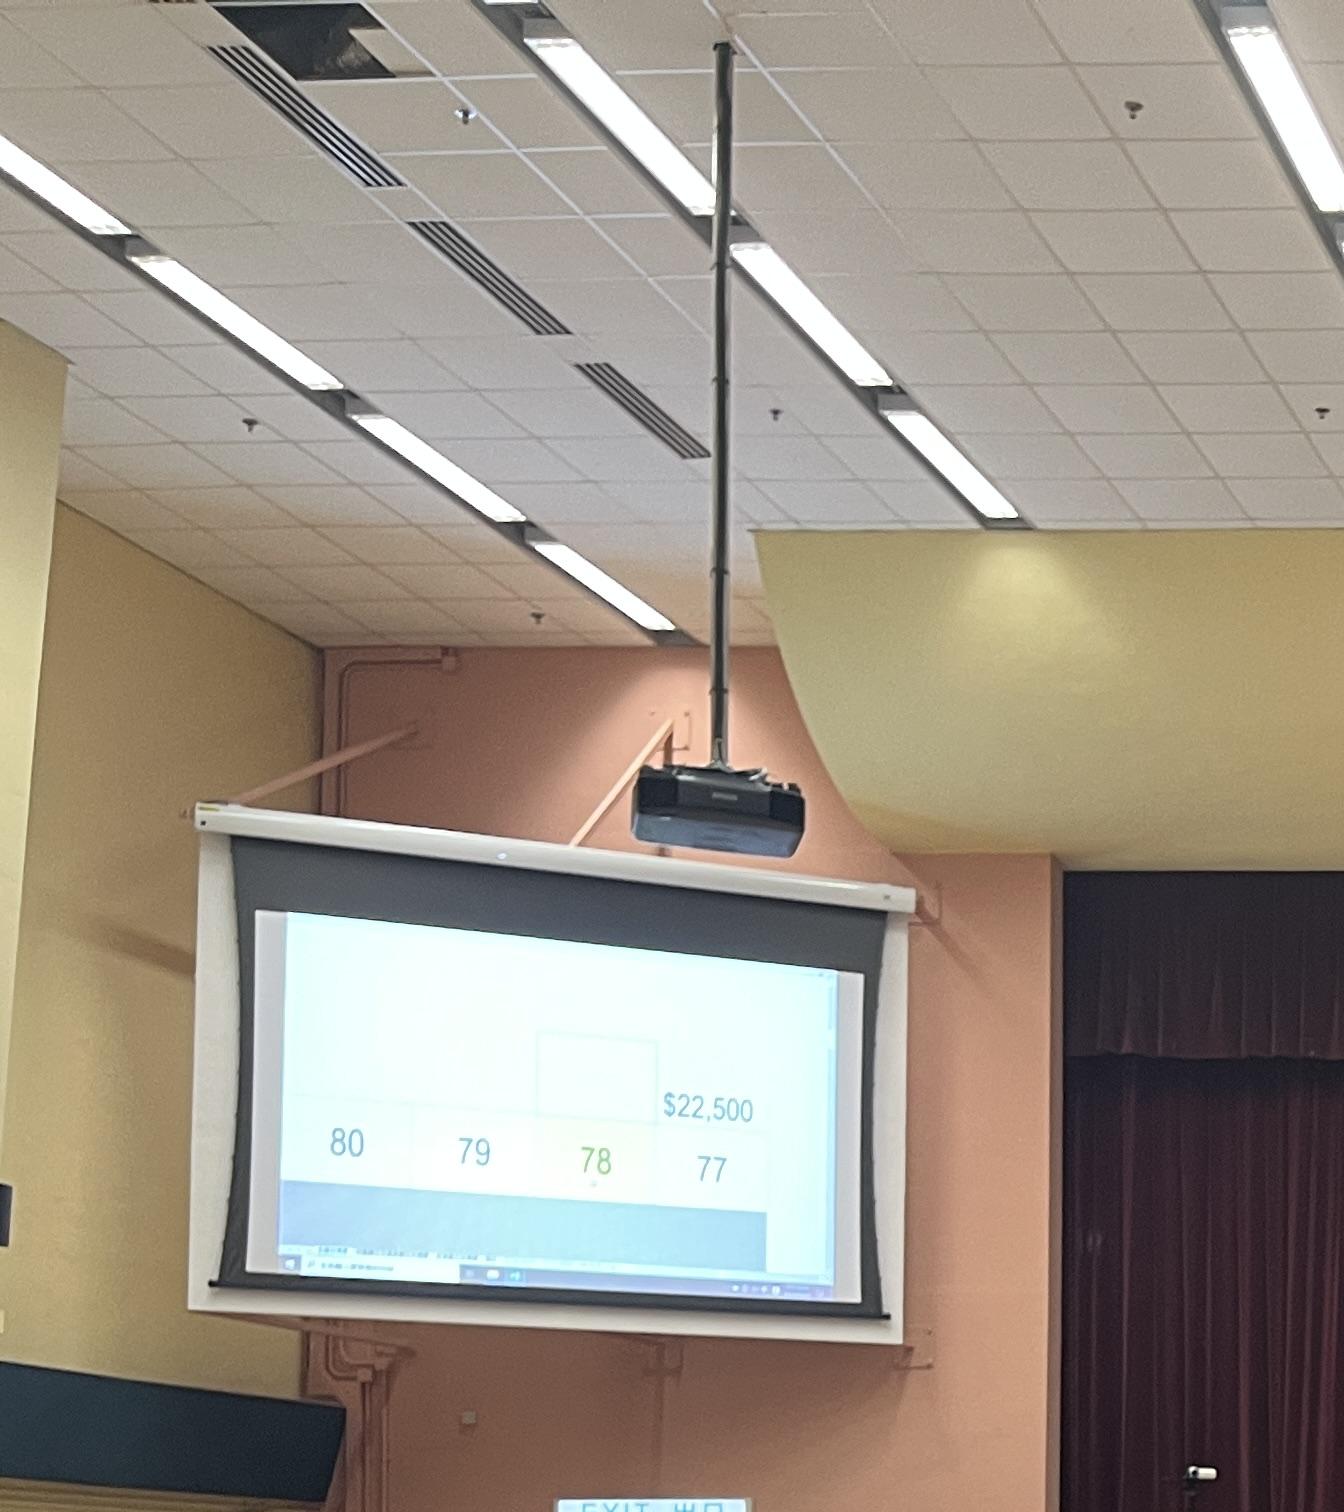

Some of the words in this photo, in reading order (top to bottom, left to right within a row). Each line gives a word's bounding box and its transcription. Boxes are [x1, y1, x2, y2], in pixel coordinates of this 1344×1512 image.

[662, 1091, 755, 1124] $22,500
[329, 1126, 366, 1158] 80
[457, 1136, 492, 1167] 79
[580, 1145, 613, 1176] 78
[696, 1154, 728, 1184] 77
